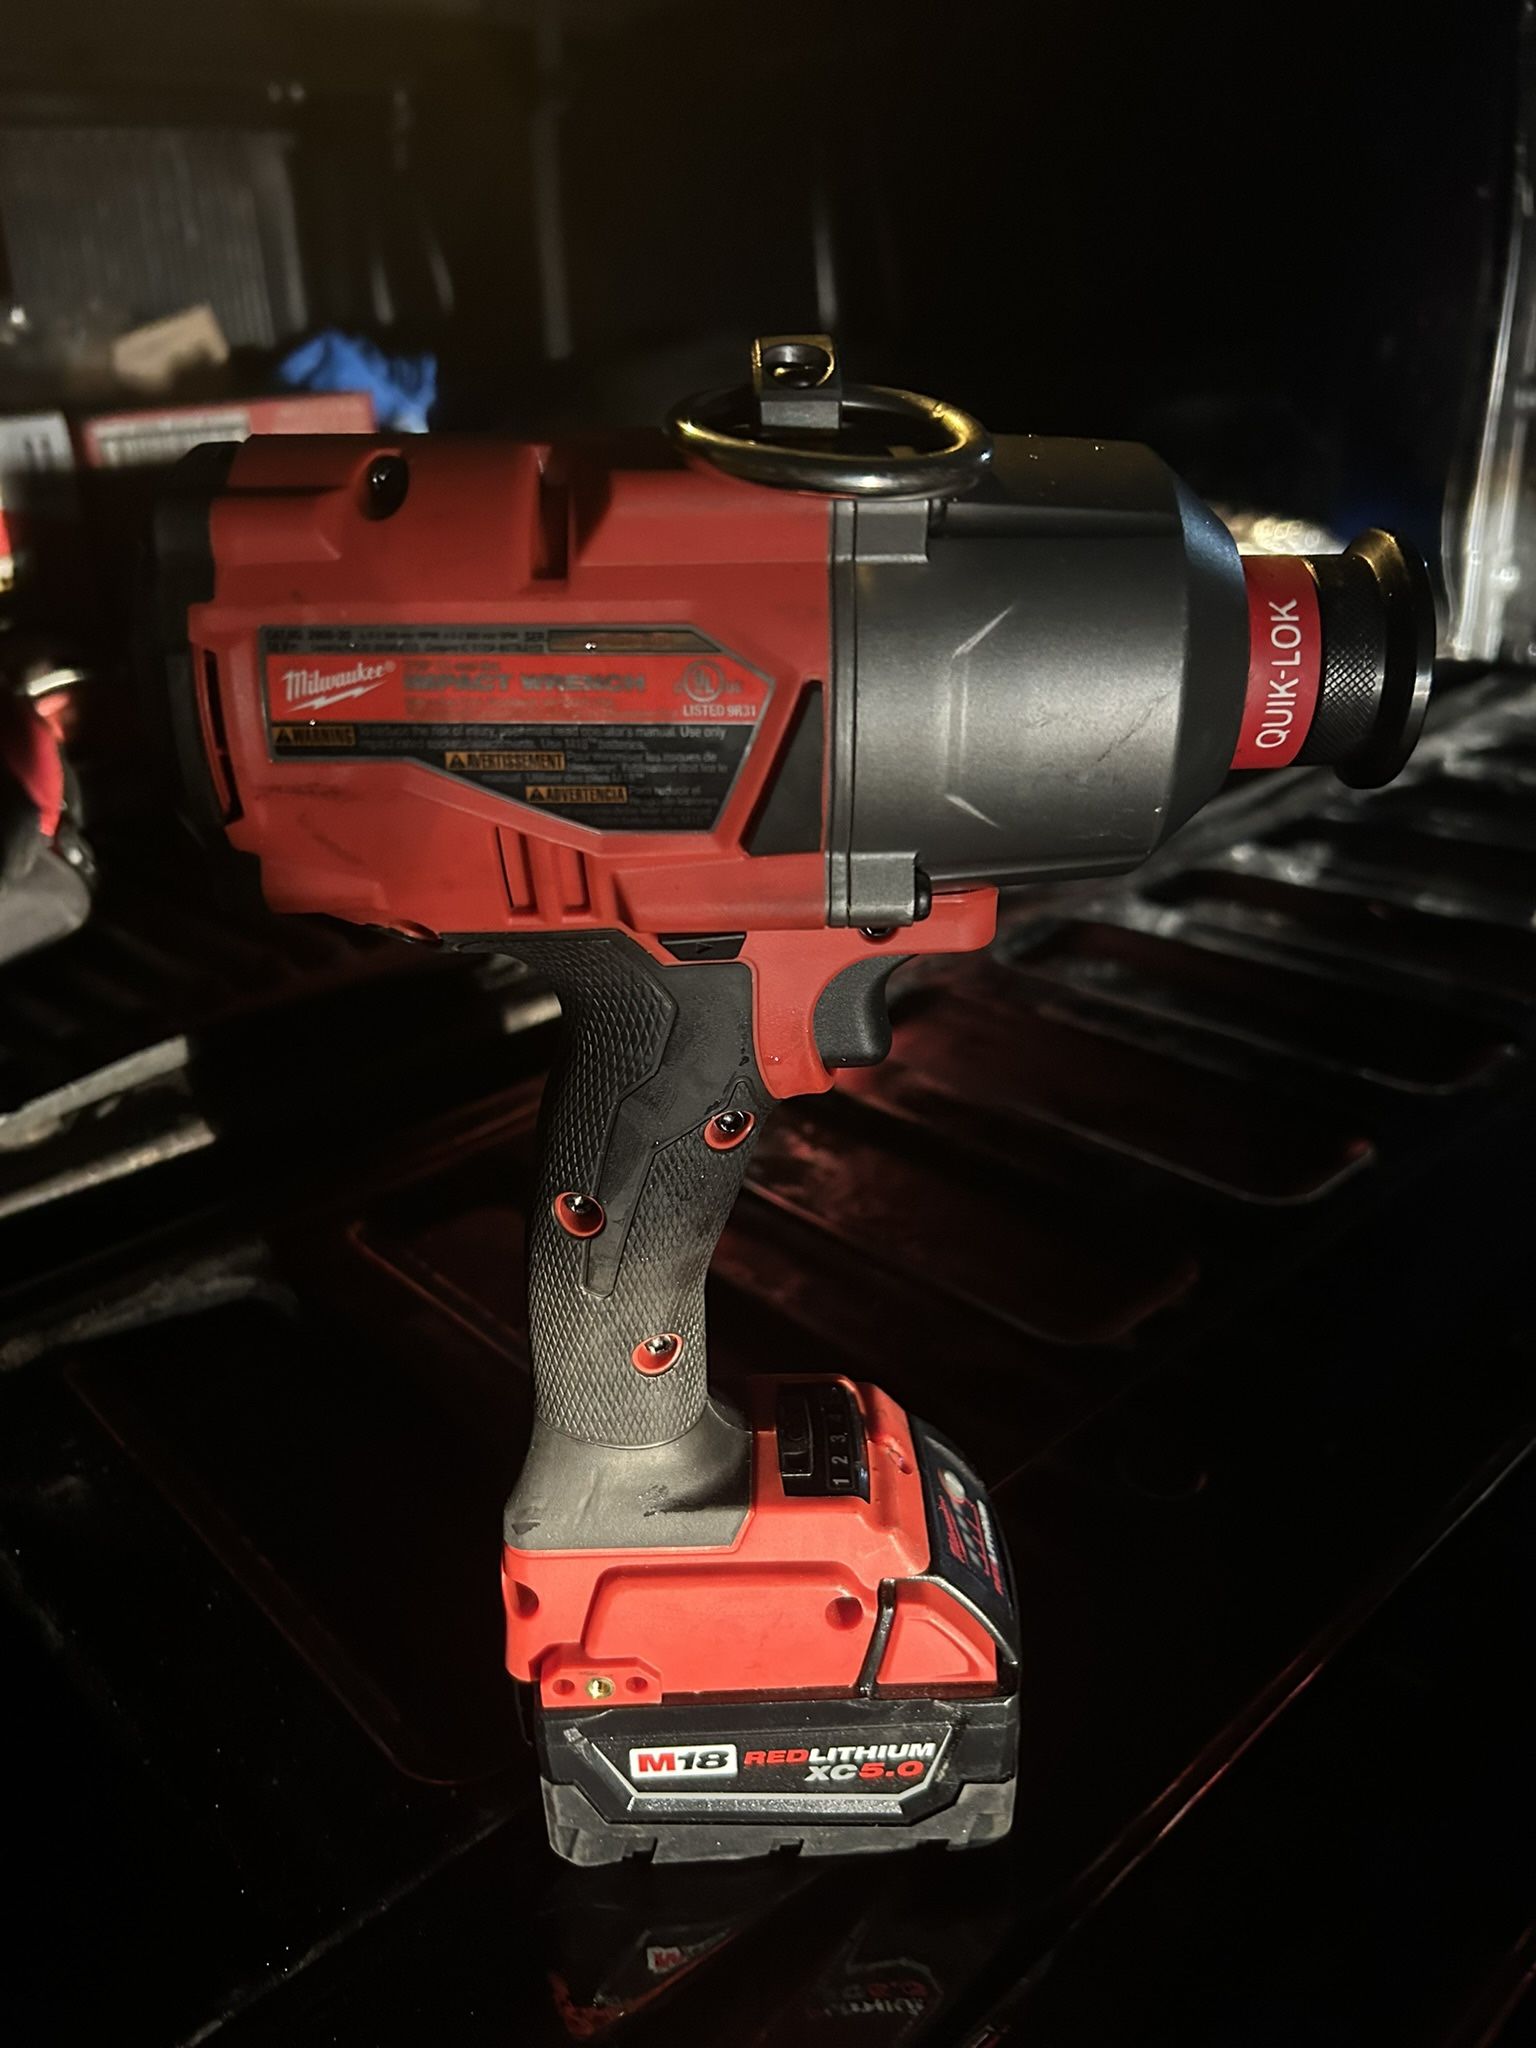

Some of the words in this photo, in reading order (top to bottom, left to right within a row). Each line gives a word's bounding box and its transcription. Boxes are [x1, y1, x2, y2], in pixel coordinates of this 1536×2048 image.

[1255, 598, 1302, 749] QUIK-LOK
[682, 704, 726, 718] LISTED
[679, 727, 702, 739] Use
[703, 727, 727, 740] only
[466, 752, 563, 770] AVERTISSEMENT
[547, 786, 627, 803] ADVERTENCIA
[831, 1454, 850, 1465] 2
[831, 1477, 851, 1486] 1
[637, 1750, 730, 1773] M18
[743, 1741, 937, 1768] REDLITHIUM
[803, 1759, 926, 1782] XC5.0
